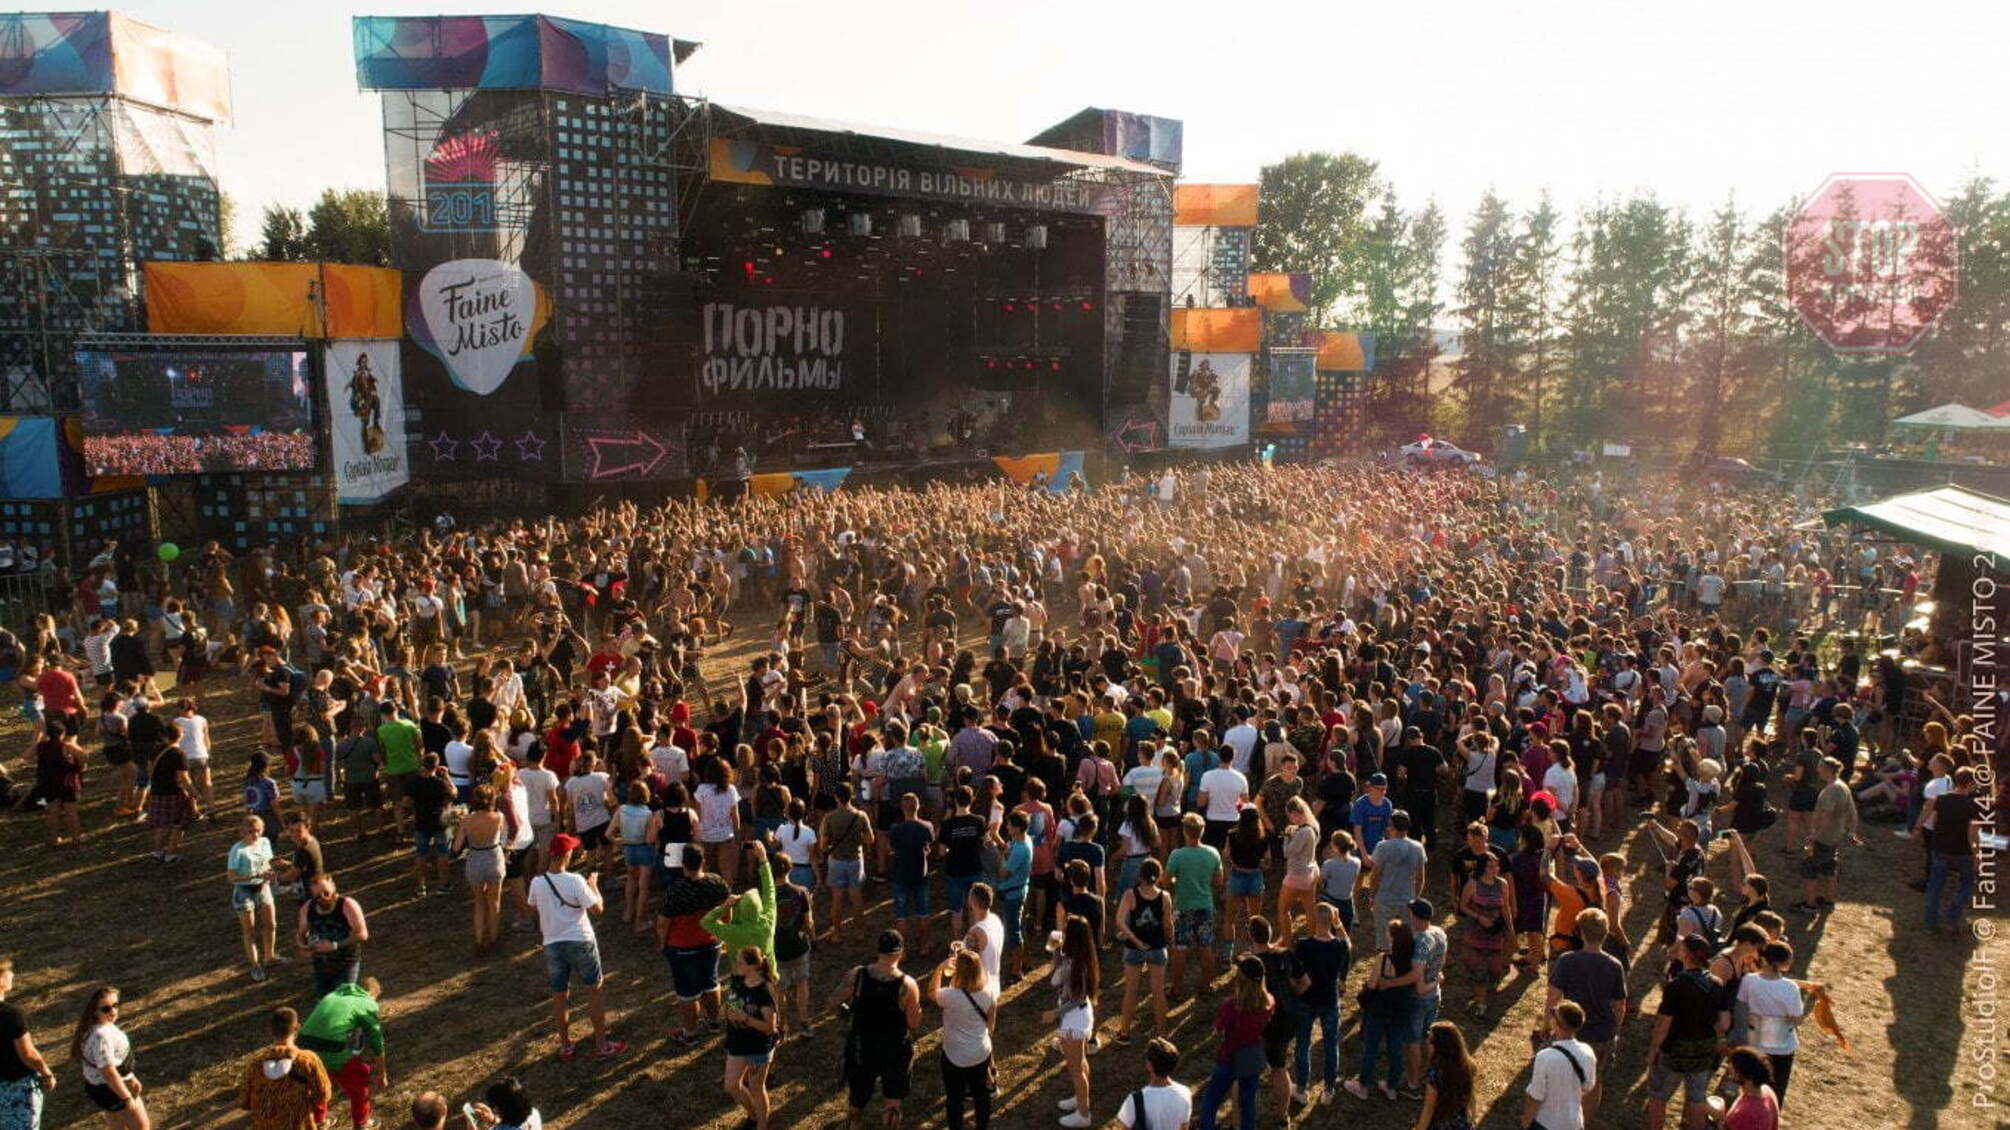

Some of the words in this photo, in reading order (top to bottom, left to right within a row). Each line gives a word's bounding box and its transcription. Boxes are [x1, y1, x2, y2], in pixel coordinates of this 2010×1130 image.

[773, 155, 910, 191] ТЕРИТОРІЯ
[920, 171, 1014, 200] ВІЛЬНИХ
[1021, 180, 1090, 209] ЛЮДЕЙ
[439, 275, 513, 325] Faine
[448, 312, 525, 357] Misto
[703, 302, 845, 357] ПОРНО
[702, 355, 842, 396] ФИЛЬМЫ
